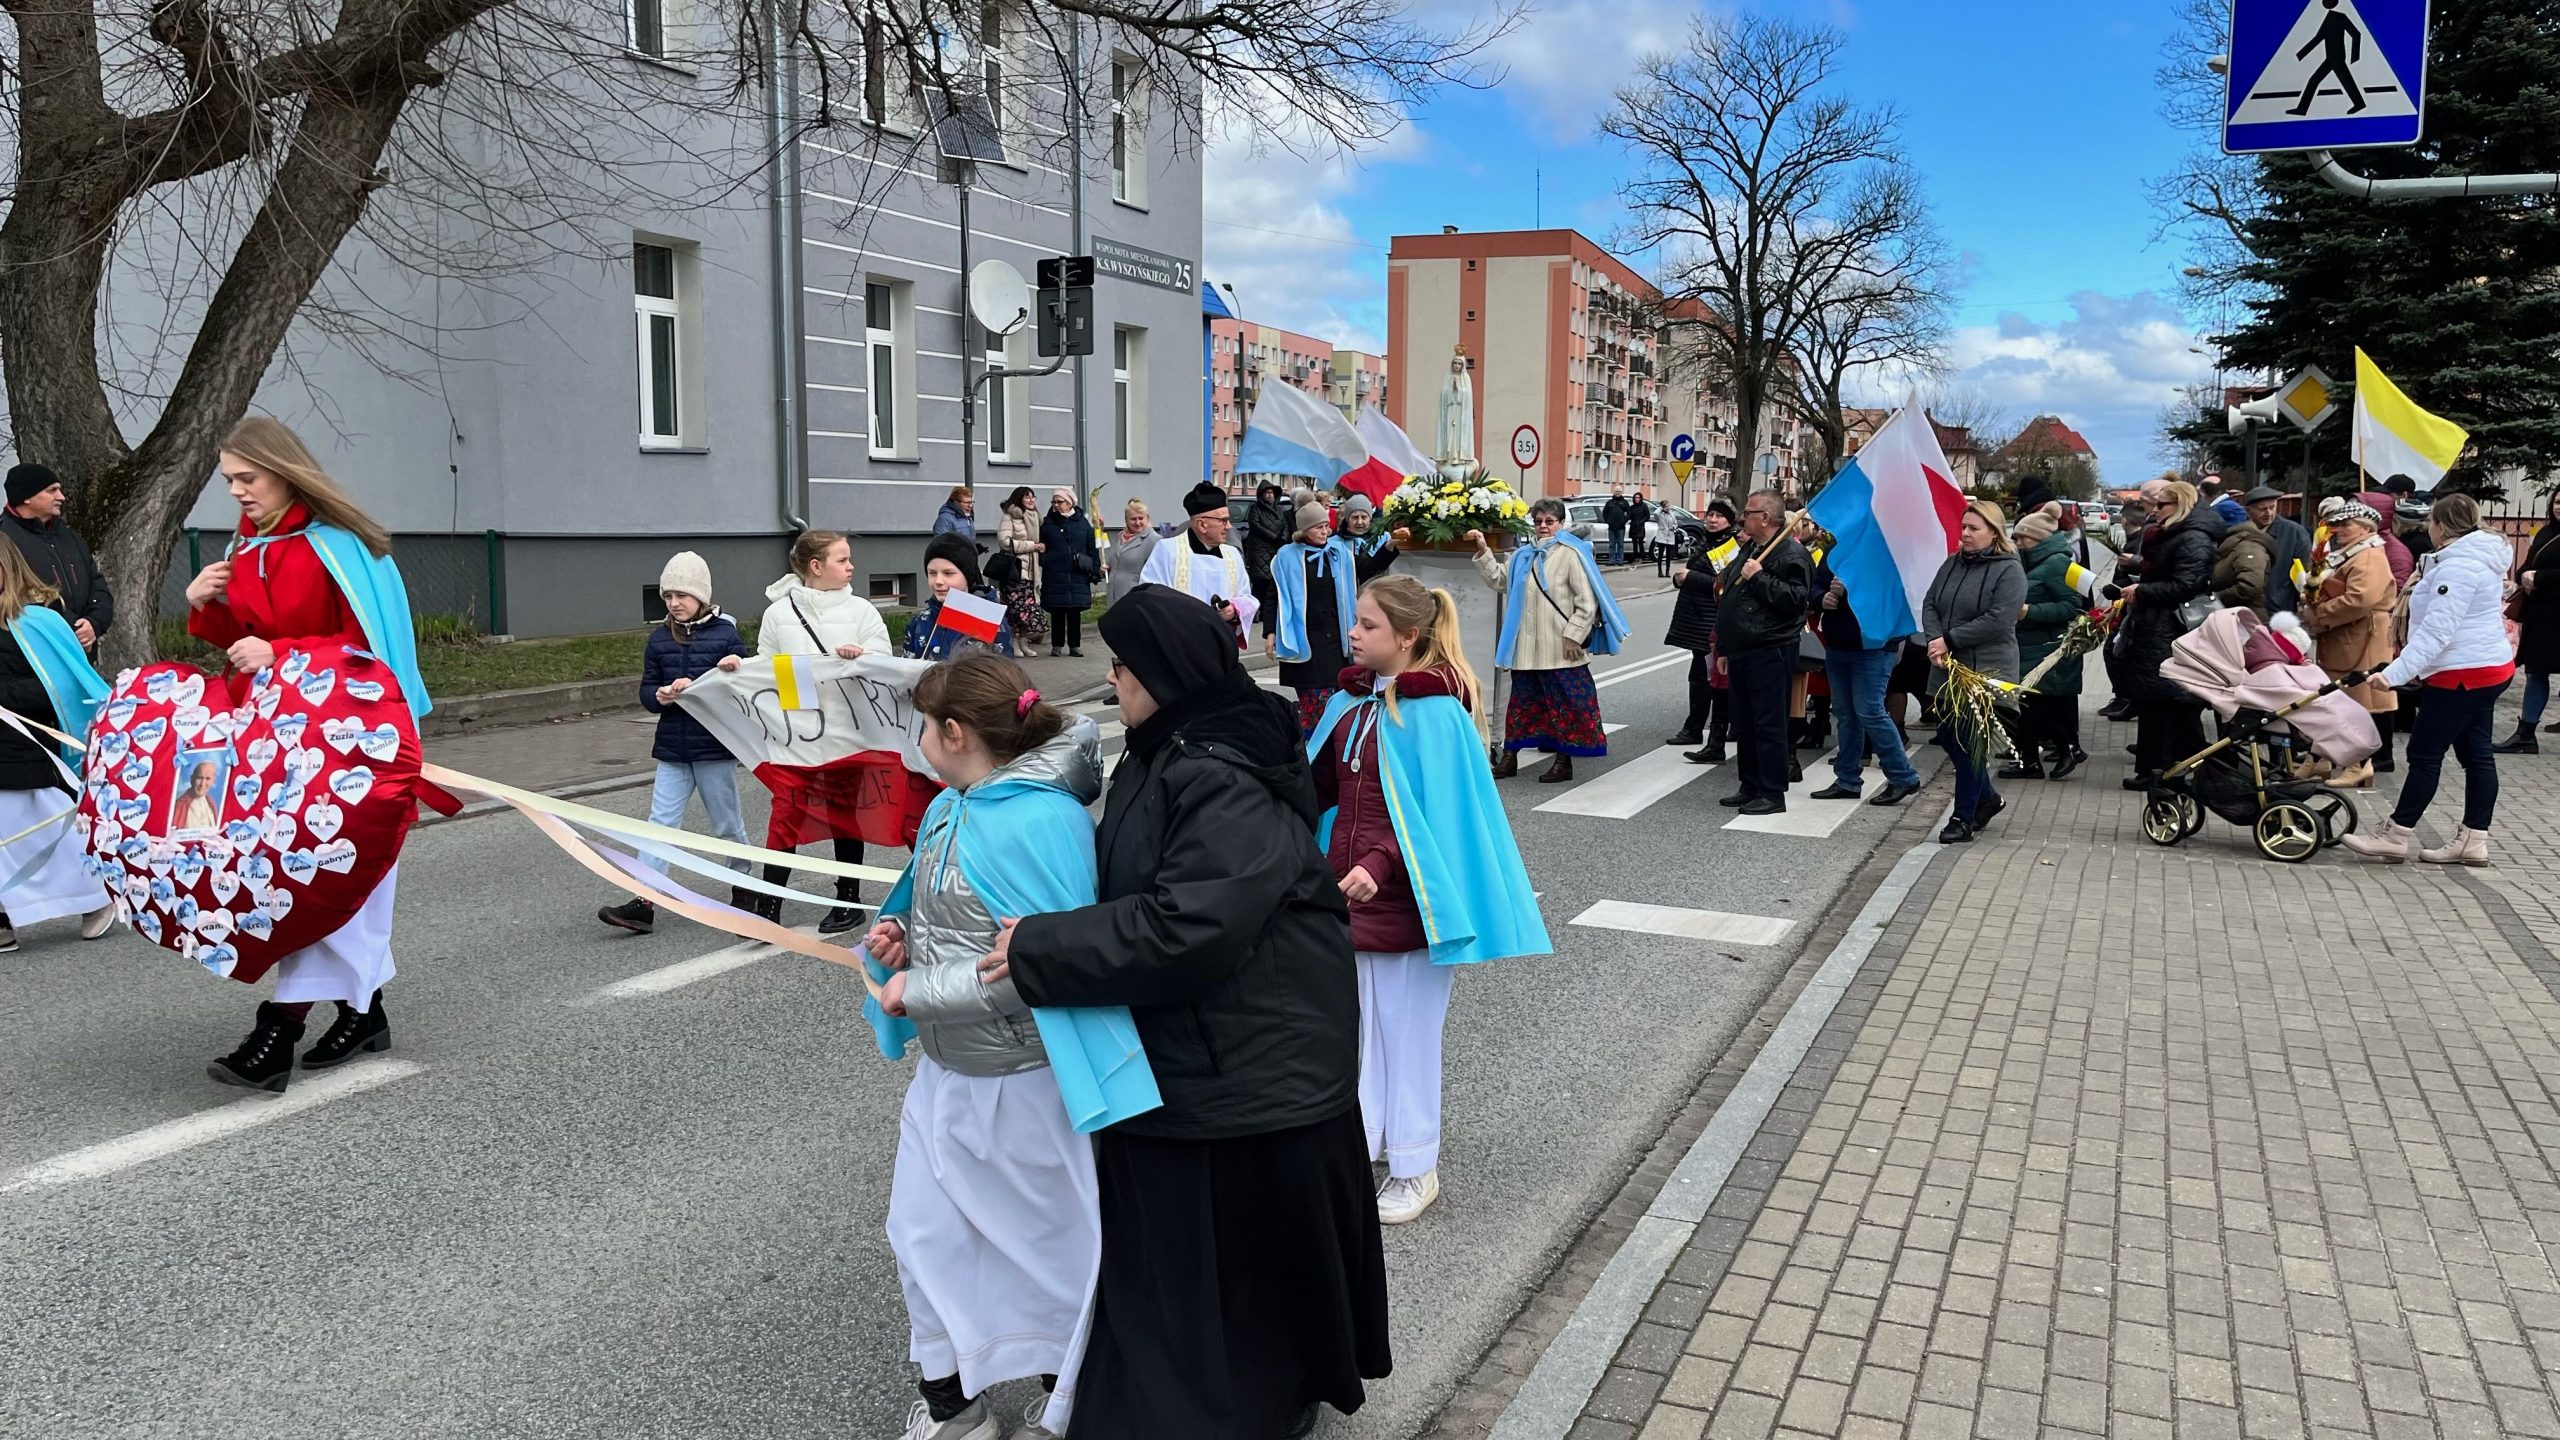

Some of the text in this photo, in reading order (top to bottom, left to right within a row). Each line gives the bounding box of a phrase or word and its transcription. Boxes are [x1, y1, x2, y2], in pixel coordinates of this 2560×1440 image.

[1174, 262, 1191, 290] 25
[280, 728, 297, 737] Eryk
[329, 732, 354, 741] Zuzia
[365, 737, 398, 755] Damian
[208, 852, 225, 860] Sara
[318, 851, 355, 867] Gabrysia
[218, 883, 230, 892] Iza
